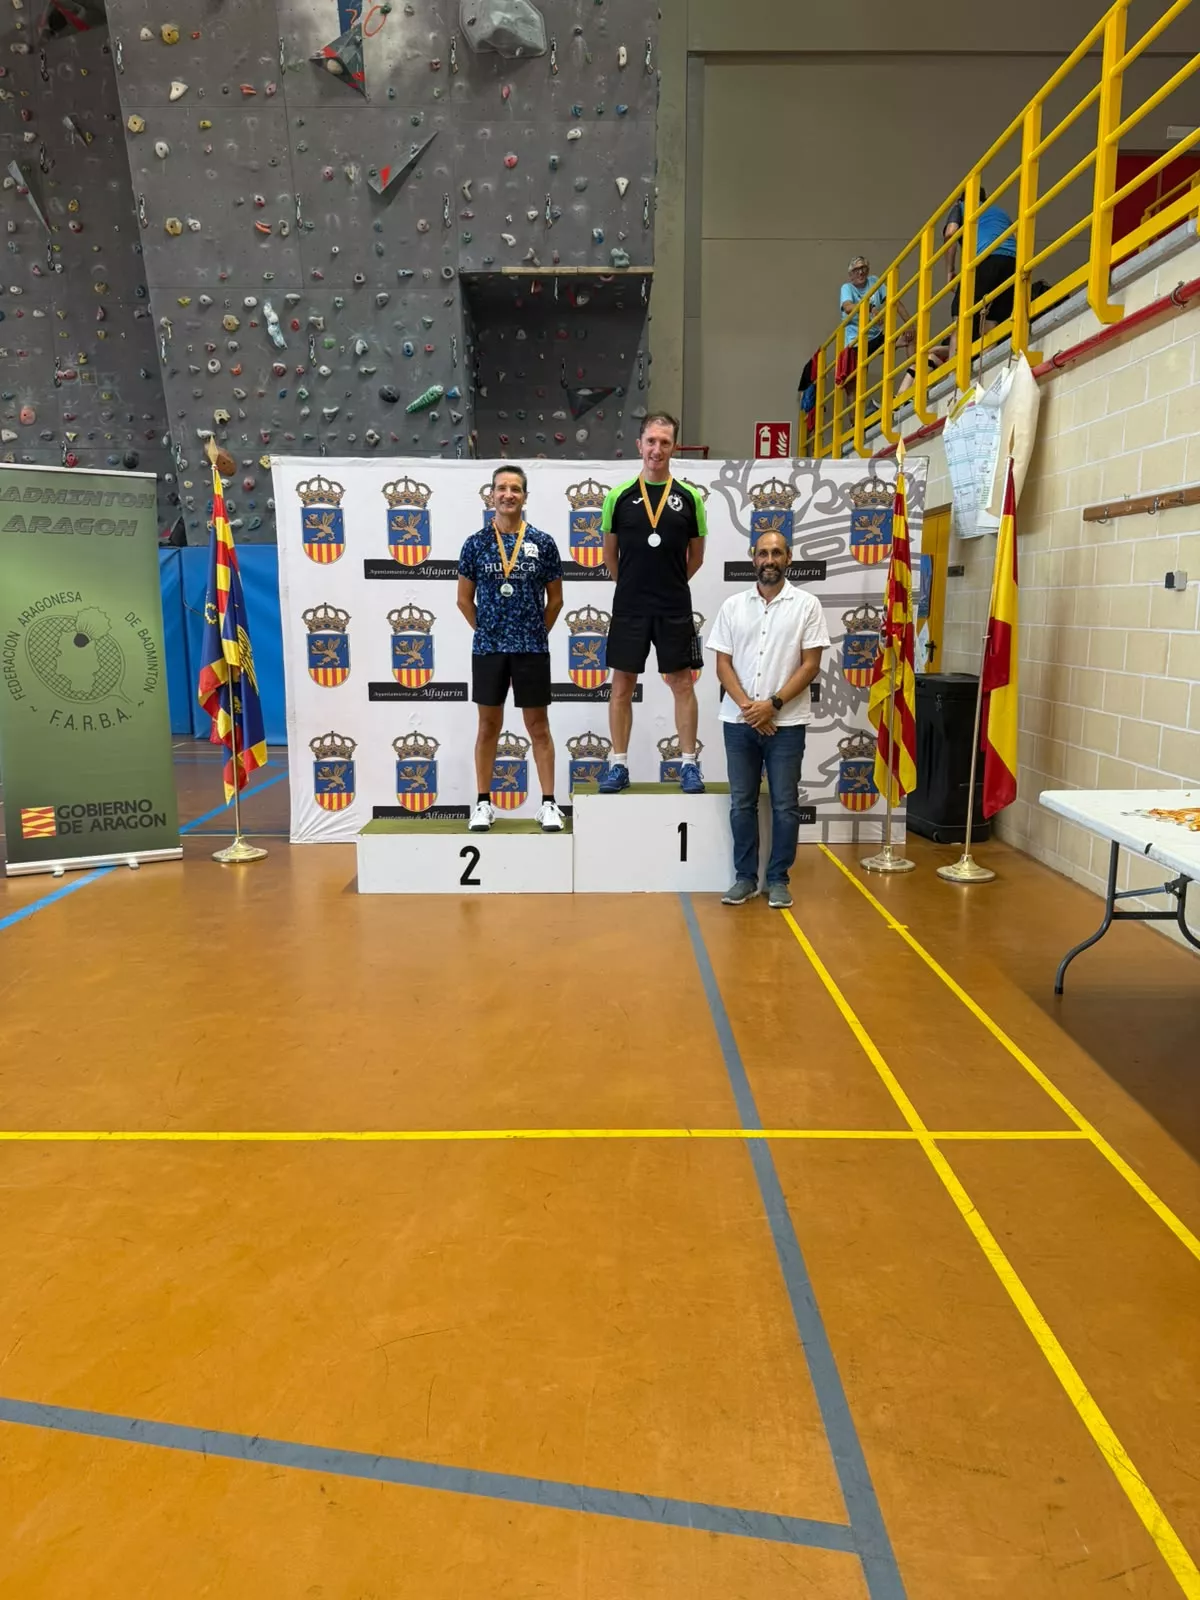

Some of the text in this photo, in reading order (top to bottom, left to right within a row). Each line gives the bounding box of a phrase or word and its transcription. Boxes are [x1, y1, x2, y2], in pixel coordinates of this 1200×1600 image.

[0, 486, 156, 508] ADMINTON
[1, 514, 138, 536] ARAGON
[2, 591, 159, 701] FEDERACION ARAGONESA DE BADMINTON
[57, 799, 153, 820] GOBIERNO
[58, 813, 166, 835] DE ARAGON
[678, 822, 688, 862] 1
[459, 845, 481, 885] 2
